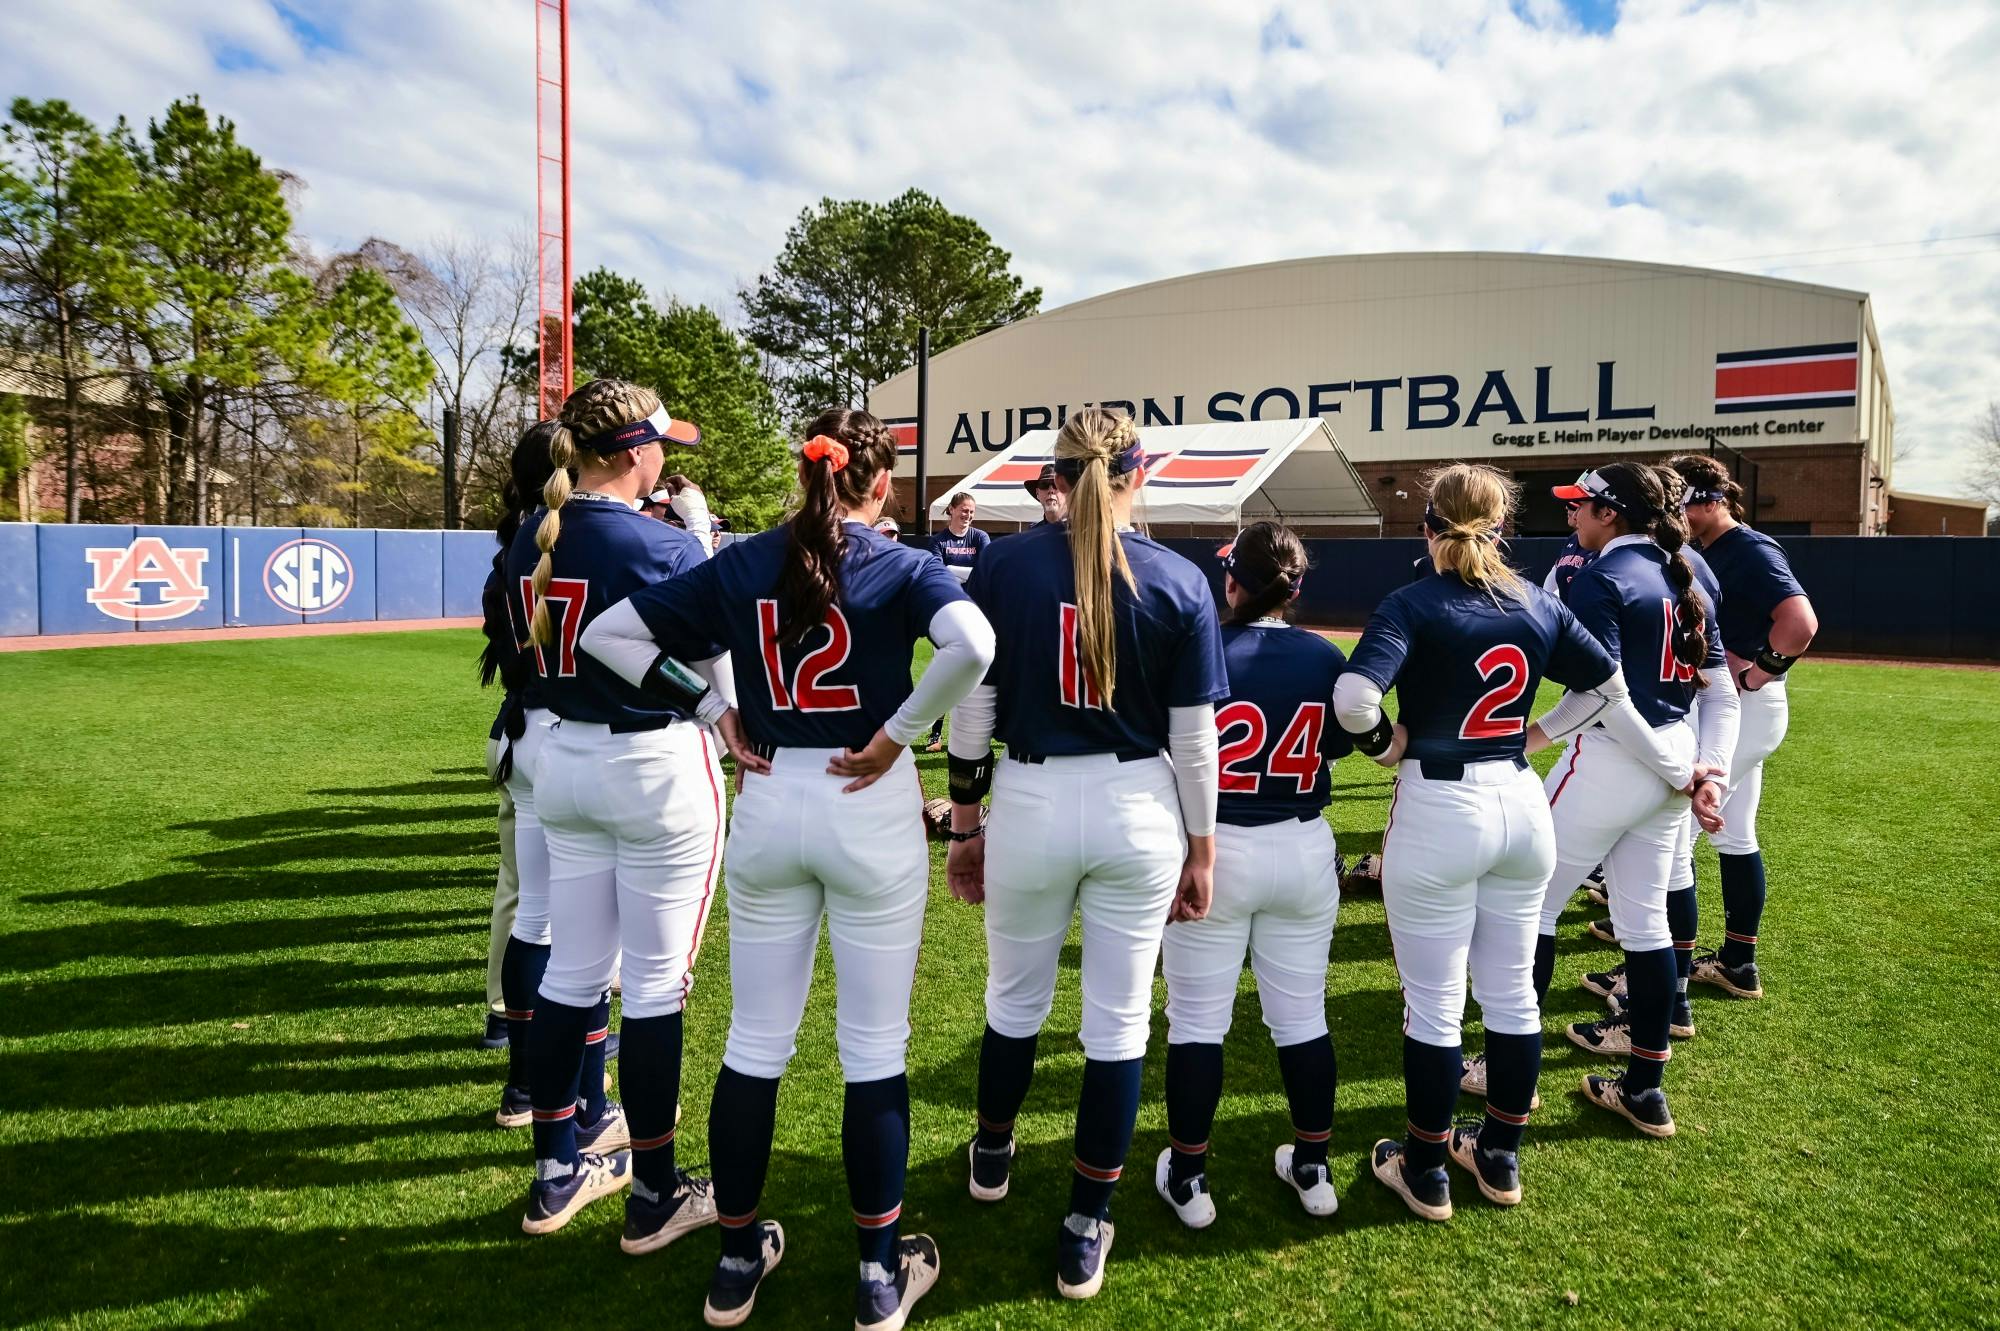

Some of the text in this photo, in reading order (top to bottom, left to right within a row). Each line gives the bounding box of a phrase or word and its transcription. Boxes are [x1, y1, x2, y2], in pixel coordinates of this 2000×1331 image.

[1207, 361, 1655, 433] SOFTBALL
[1492, 419, 1825, 447] Gregg E. Heim Player Development Center
[271, 544, 346, 609] SEC
[520, 576, 588, 677] 17
[756, 598, 861, 713] 12
[1458, 643, 1529, 740] 2
[1215, 700, 1325, 794] 24
